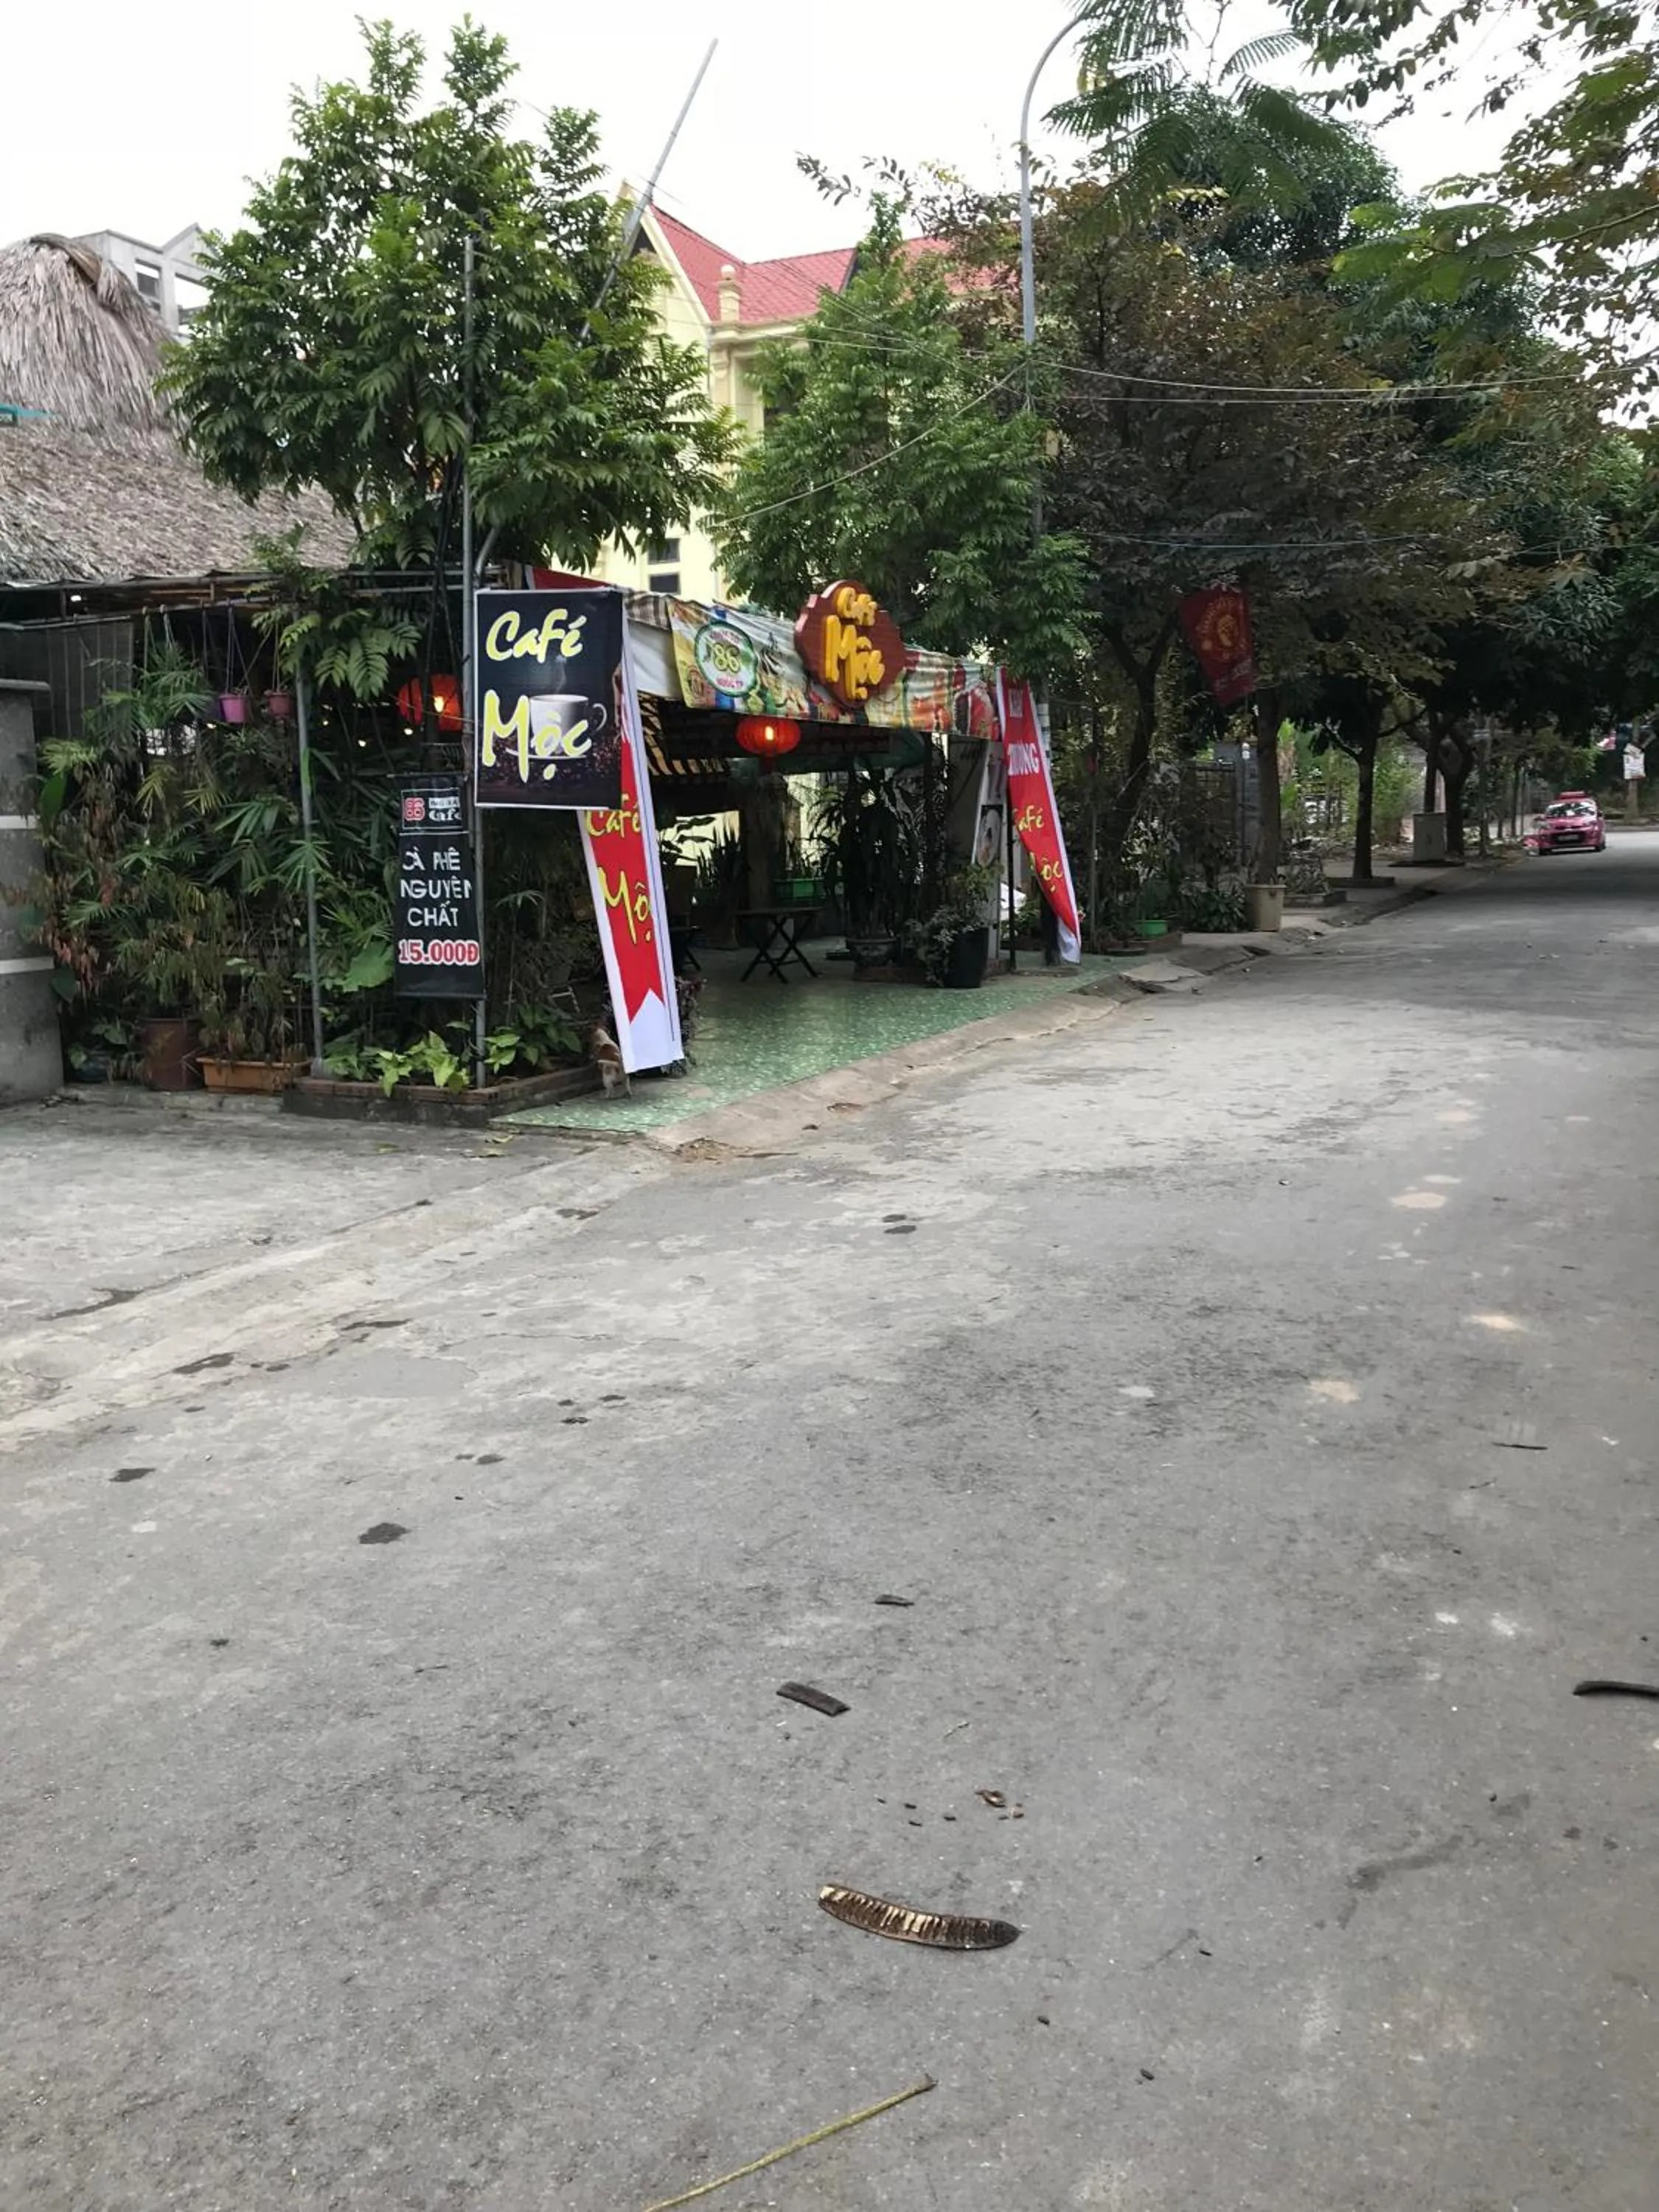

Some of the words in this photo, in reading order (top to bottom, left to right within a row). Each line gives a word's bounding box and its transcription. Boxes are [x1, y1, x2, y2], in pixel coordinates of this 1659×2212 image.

[485, 608, 588, 664] Café
[825, 614, 885, 700] Mộc
[481, 689, 592, 783] Mộc
[405, 797, 425, 821] 86
[1013, 804, 1045, 832] afé
[400, 875, 473, 899] NGUYÊN
[407, 900, 459, 927] CHẤT
[598, 866, 652, 945] Mộ
[398, 939, 481, 965] 15.000Đ
